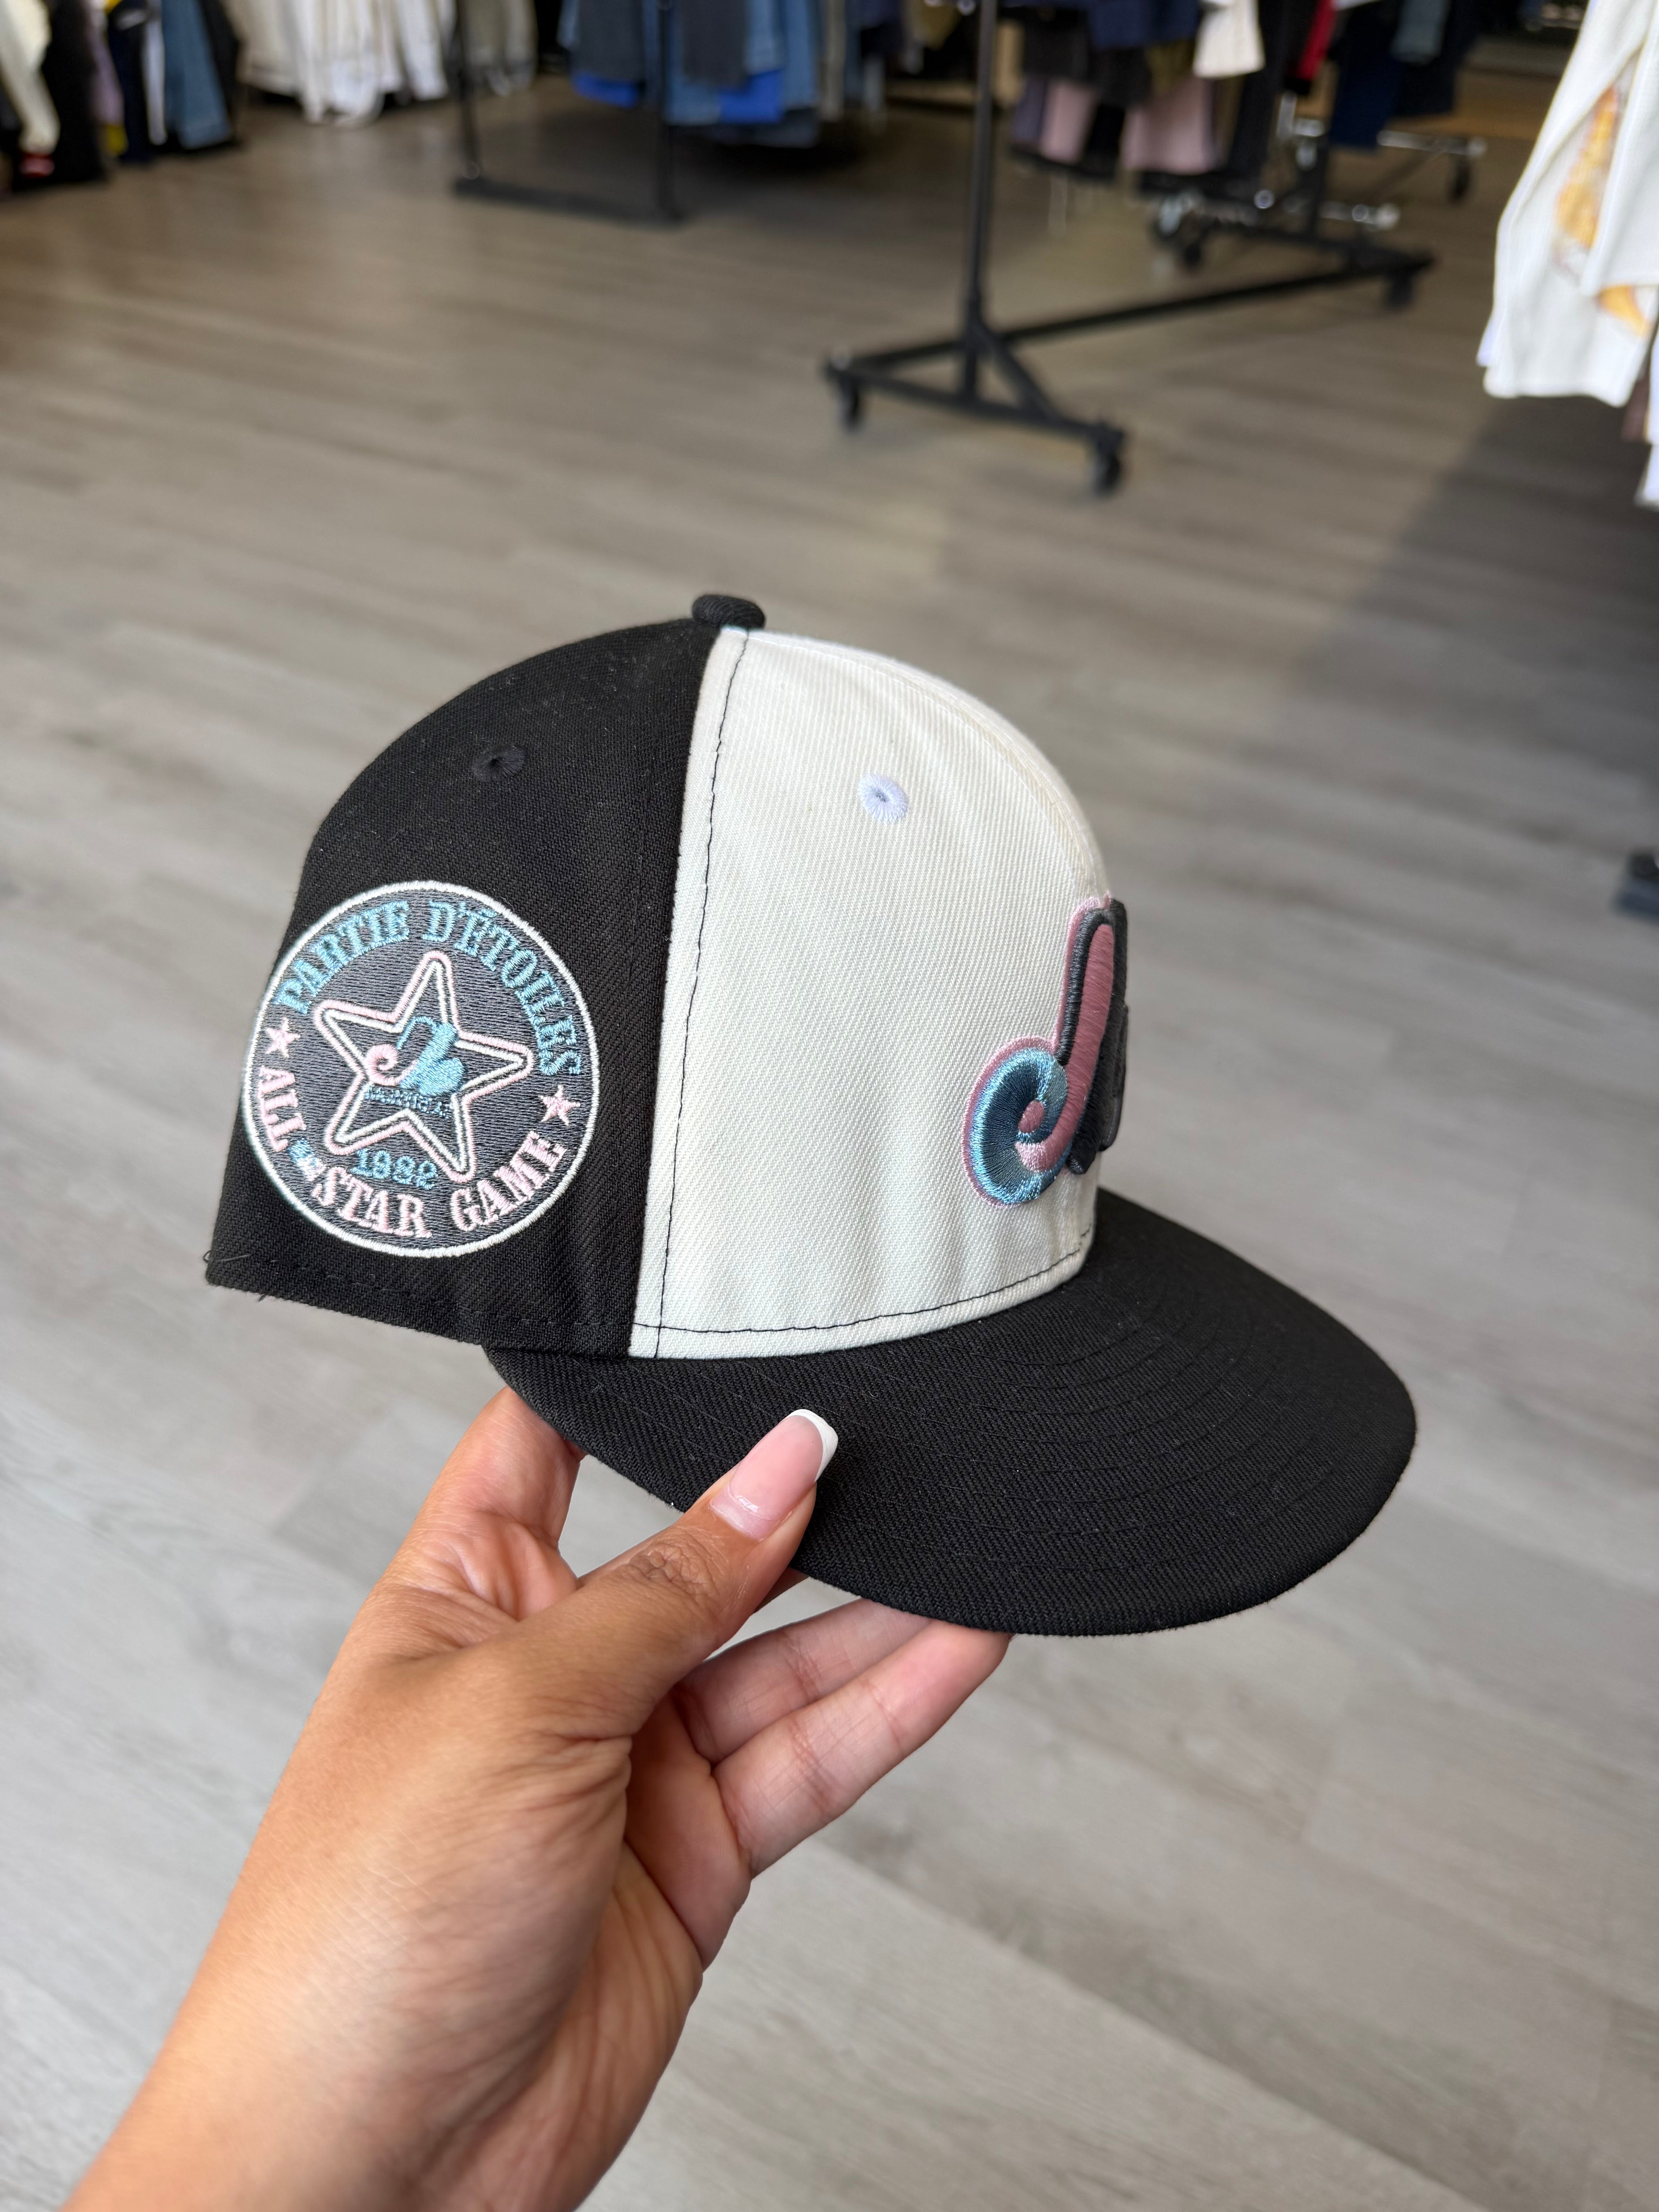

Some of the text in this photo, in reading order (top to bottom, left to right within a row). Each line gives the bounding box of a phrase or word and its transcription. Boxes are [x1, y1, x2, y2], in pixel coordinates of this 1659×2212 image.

[272, 901, 410, 1014] PARTIE
[258, 1065, 567, 1238] ALL STAR GAME
